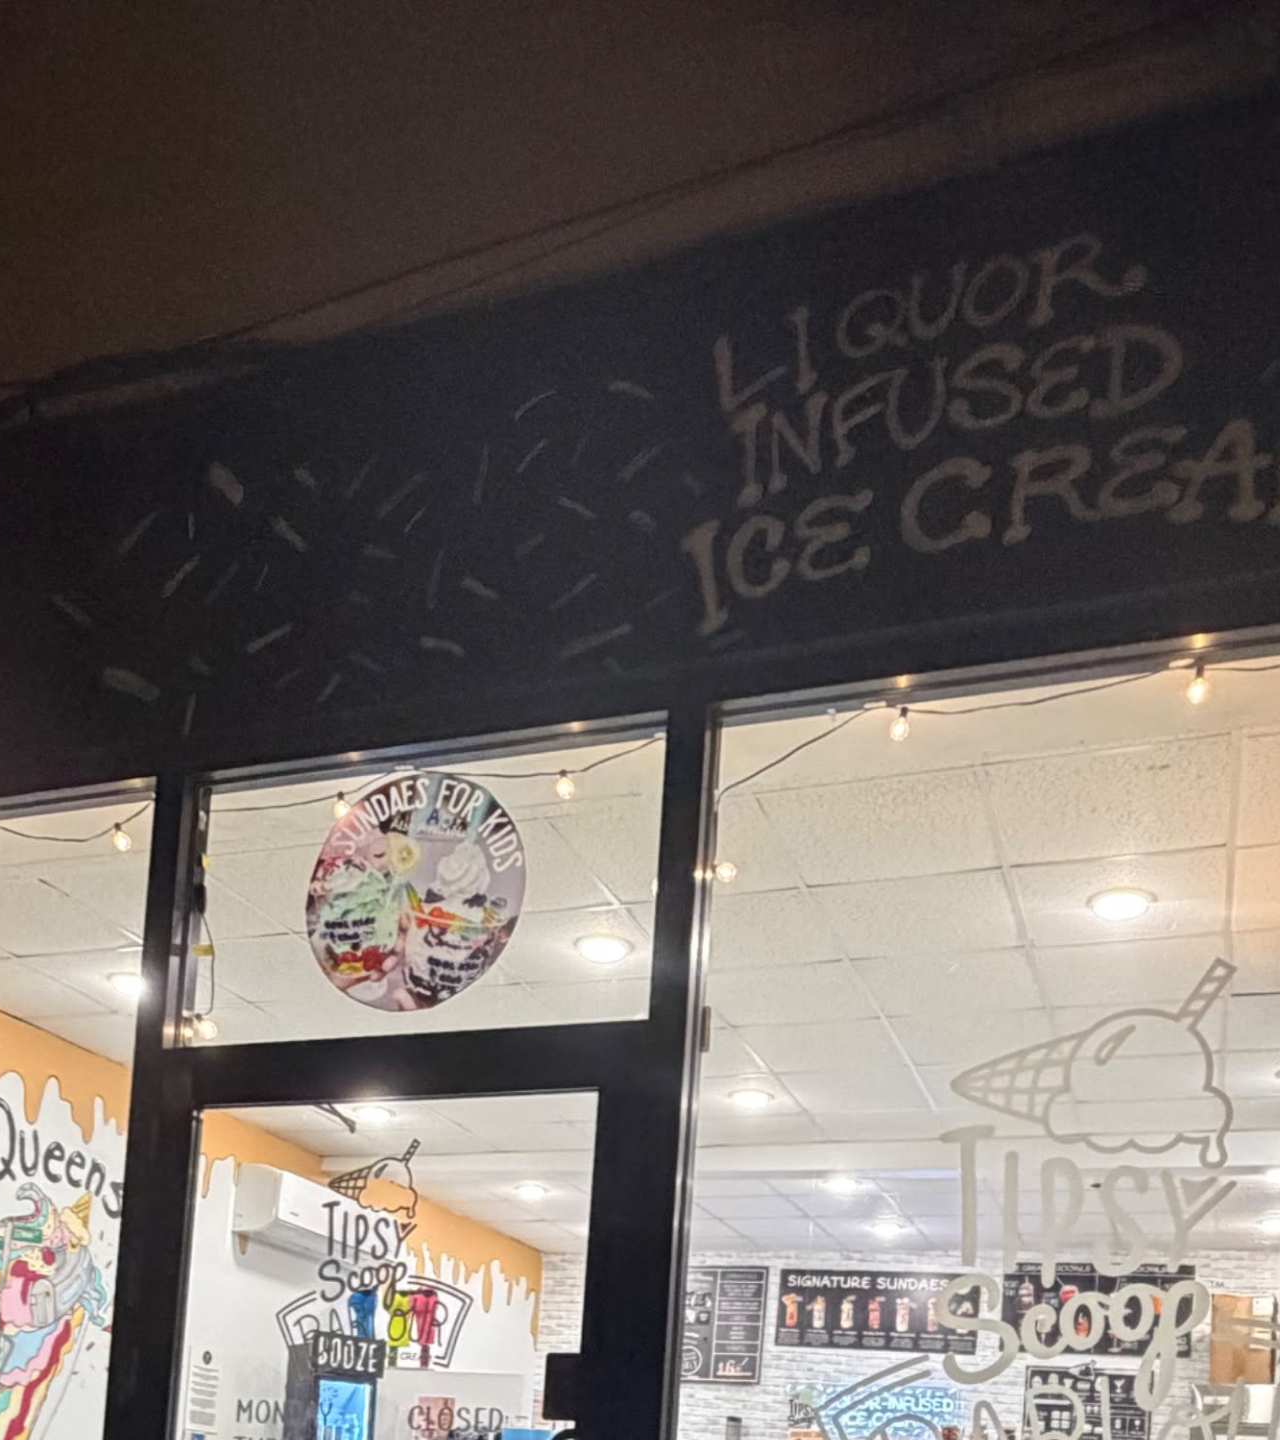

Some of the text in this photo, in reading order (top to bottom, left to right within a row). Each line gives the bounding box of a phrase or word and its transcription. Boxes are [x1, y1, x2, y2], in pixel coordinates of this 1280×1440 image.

[713, 233, 1145, 412] LIQUOR
[730, 324, 1185, 508] INFUSED
[681, 490, 874, 636] ICE
[332, 777, 523, 873] SUNDAES FOR KIDS
[321, 1200, 418, 1265] TIPSY
[940, 1124, 1238, 1289] TIPSY
[318, 1259, 408, 1311] Scoop
[786, 1274, 952, 1292] SIGNATURE SUNDAES
[317, 1335, 379, 1374] BOOZE
[935, 1273, 1211, 1412] Scoop
[407, 1405, 504, 1433] CLOSED
